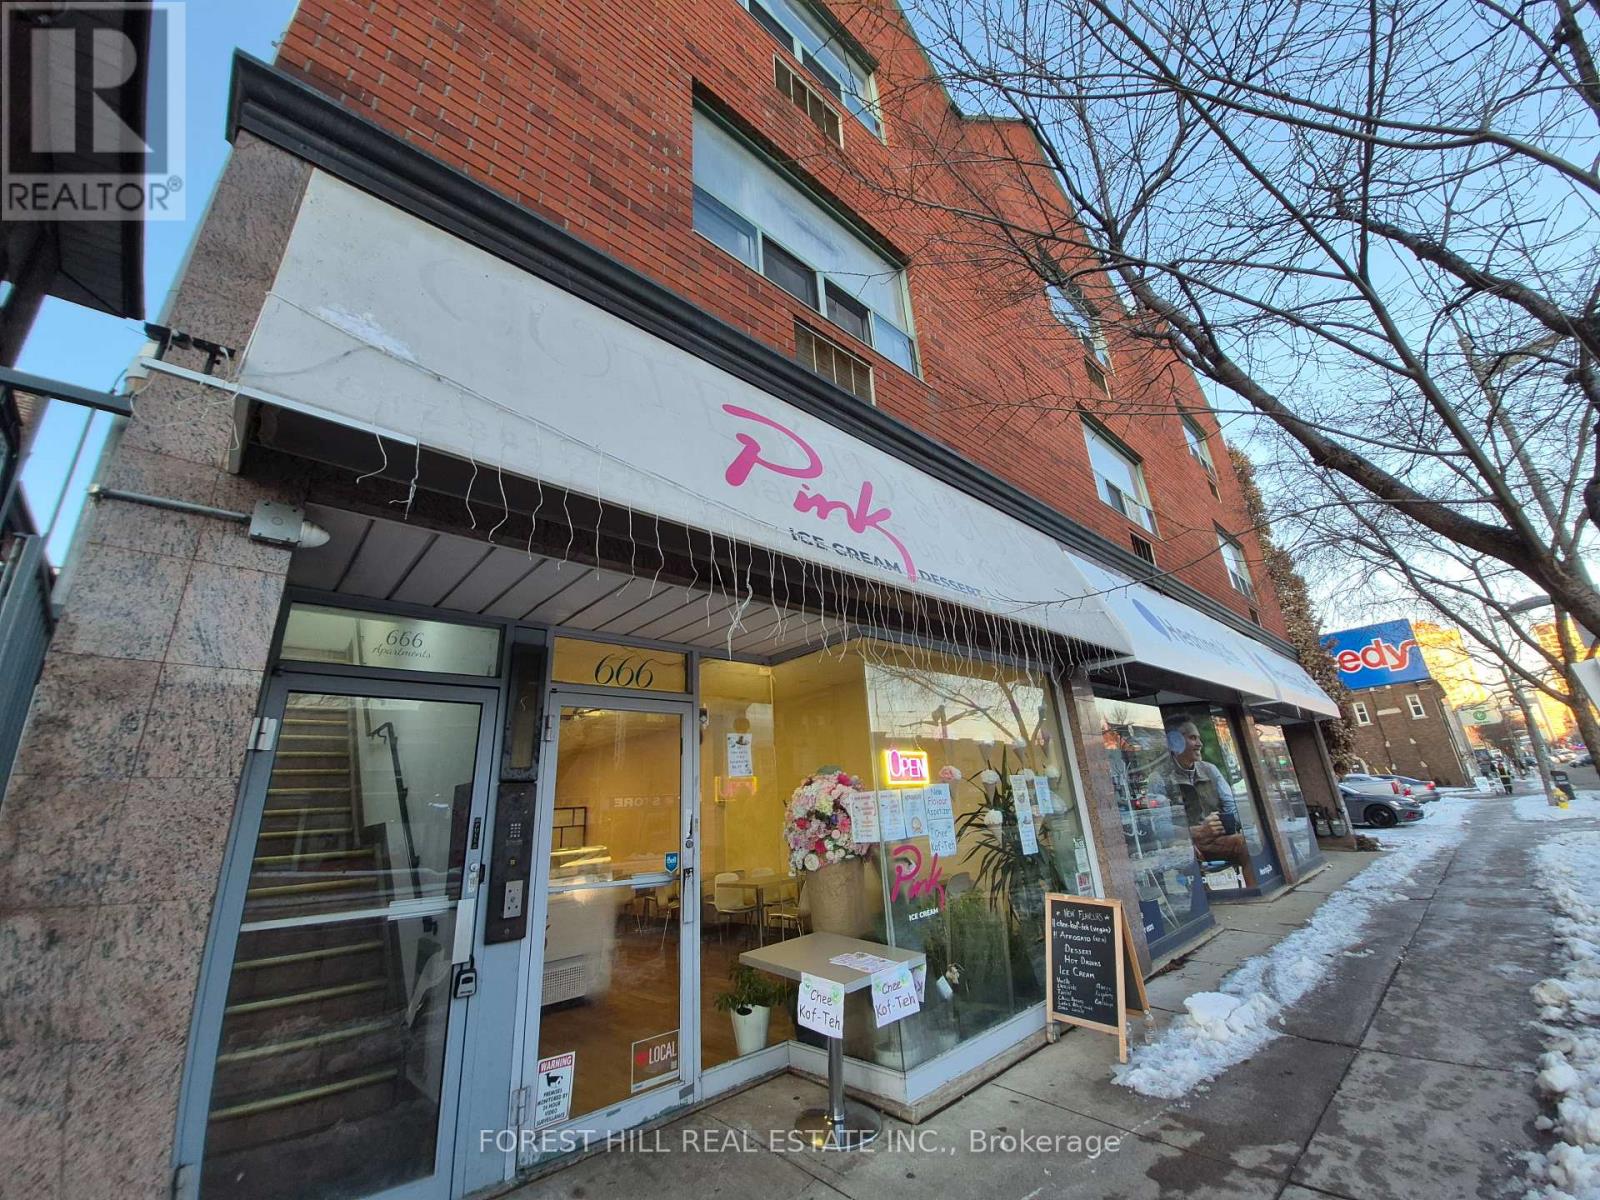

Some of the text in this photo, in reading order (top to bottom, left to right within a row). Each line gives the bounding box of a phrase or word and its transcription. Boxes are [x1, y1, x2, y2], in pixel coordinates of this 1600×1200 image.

[722, 403, 917, 582] Pink
[789, 528, 985, 597] ICE CREAM DESSERT
[386, 629, 425, 648] 666
[1332, 638, 1418, 673] edy
[594, 652, 654, 688] 666
[908, 907, 939, 921] ICE CREAM
[811, 989, 832, 1006] Chee
[881, 980, 902, 995] Chee
[799, 1003, 841, 1031] Kof-Teh
[875, 992, 916, 1018] Kof-Teh
[541, 1055, 572, 1071] WARNING
[649, 1041, 677, 1065] LOCAL
